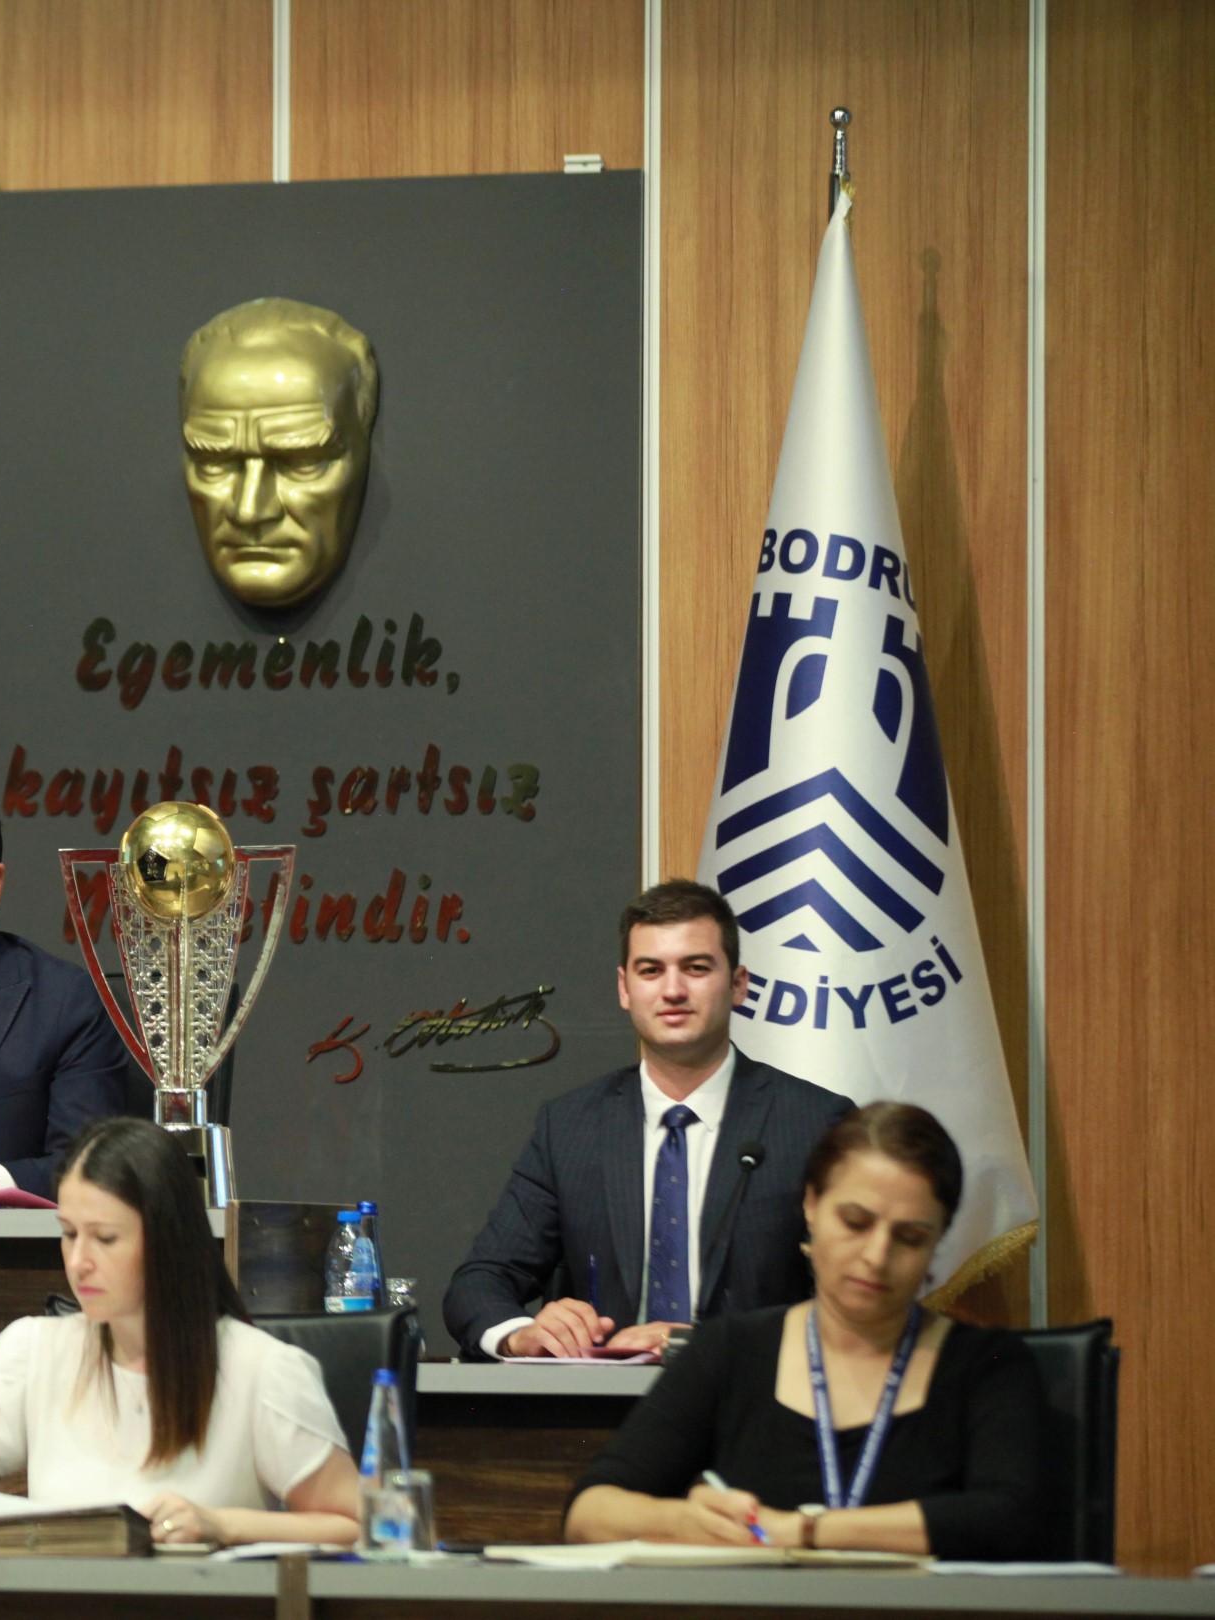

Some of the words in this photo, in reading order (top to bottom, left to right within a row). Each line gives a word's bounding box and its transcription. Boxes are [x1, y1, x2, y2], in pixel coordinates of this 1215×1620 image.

[75, 612, 461, 711] Egemenlik,
[2, 744, 281, 834] kayıtsız
[301, 743, 541, 837] şartsız
[731, 934, 964, 1030] EDİYESİ
